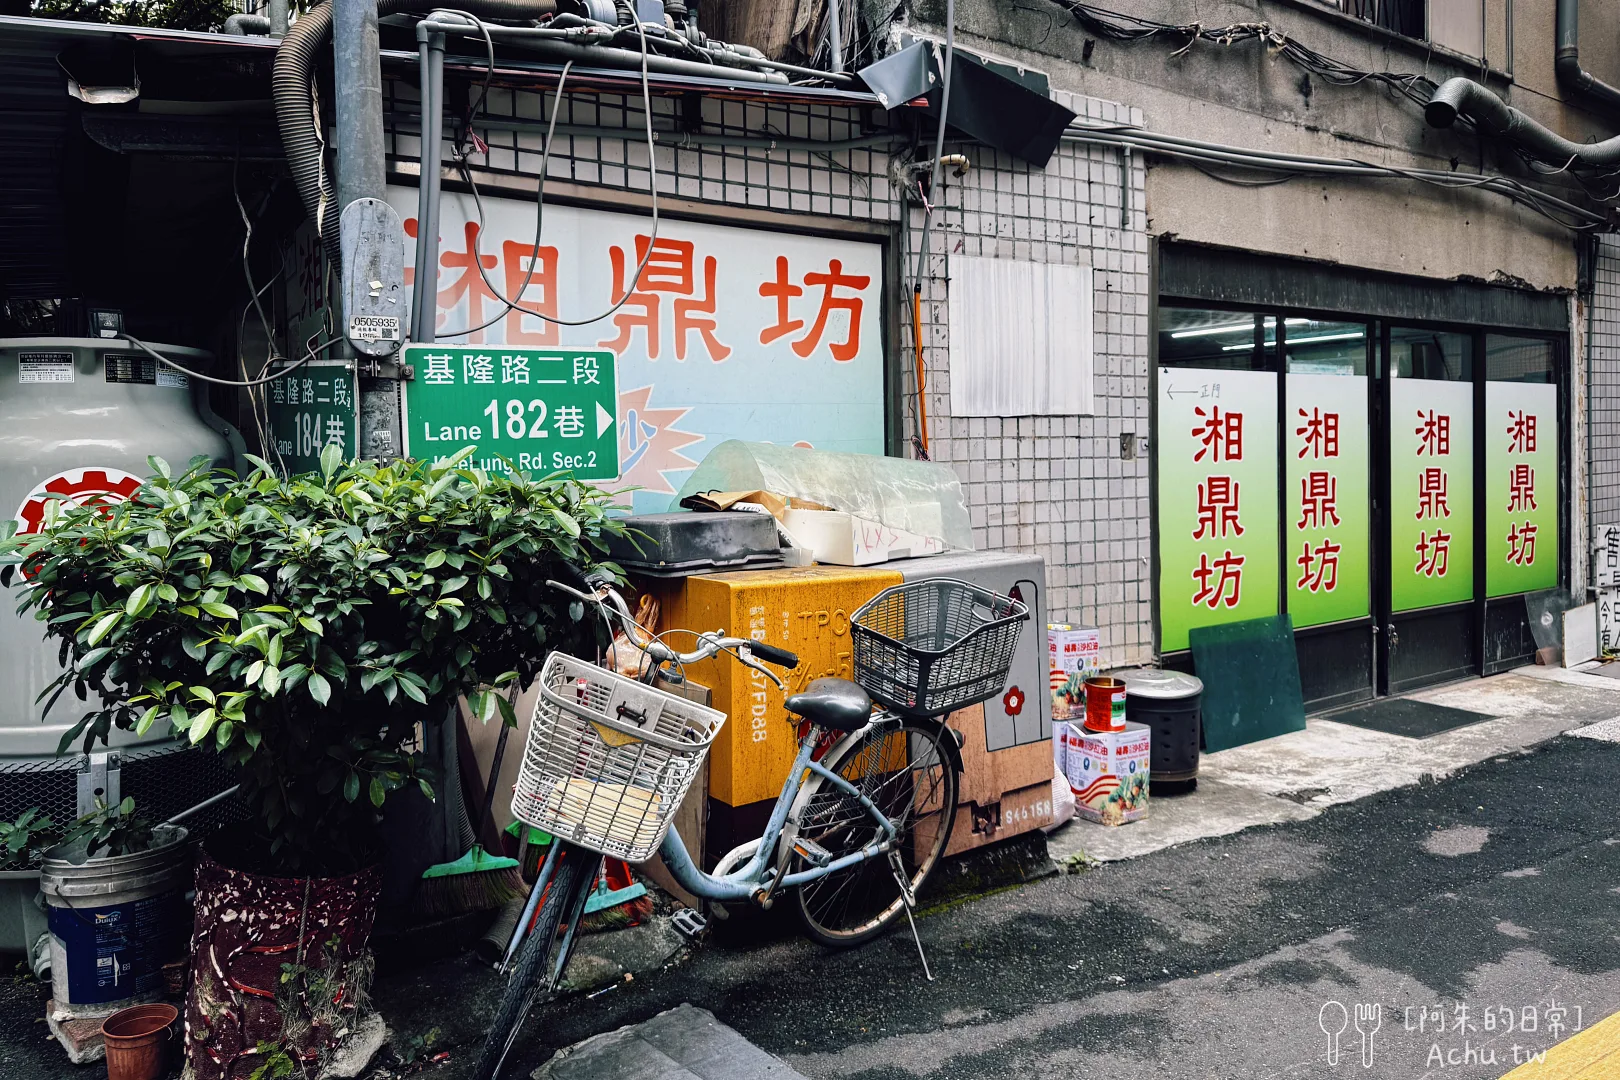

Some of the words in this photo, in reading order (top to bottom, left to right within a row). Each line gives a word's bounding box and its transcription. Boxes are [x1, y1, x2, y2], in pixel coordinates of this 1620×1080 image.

[402, 218, 871, 362] 湘鼎坊
[354, 317, 396, 328] 0505935
[423, 353, 600, 385] 基隆路二段
[273, 376, 347, 405] 基隆路二段
[424, 421, 482, 441] Lane
[519, 452, 547, 470] Rd.
[552, 450, 597, 469] Sec.2
[1296, 406, 1341, 592] 湘鼎坊
[1415, 409, 1451, 577] 湘鼎坊
[1506, 409, 1538, 565] 湘鼎坊
[1191, 404, 1245, 609] 湘鼎坊
[95, 915, 118, 924] Dulux
